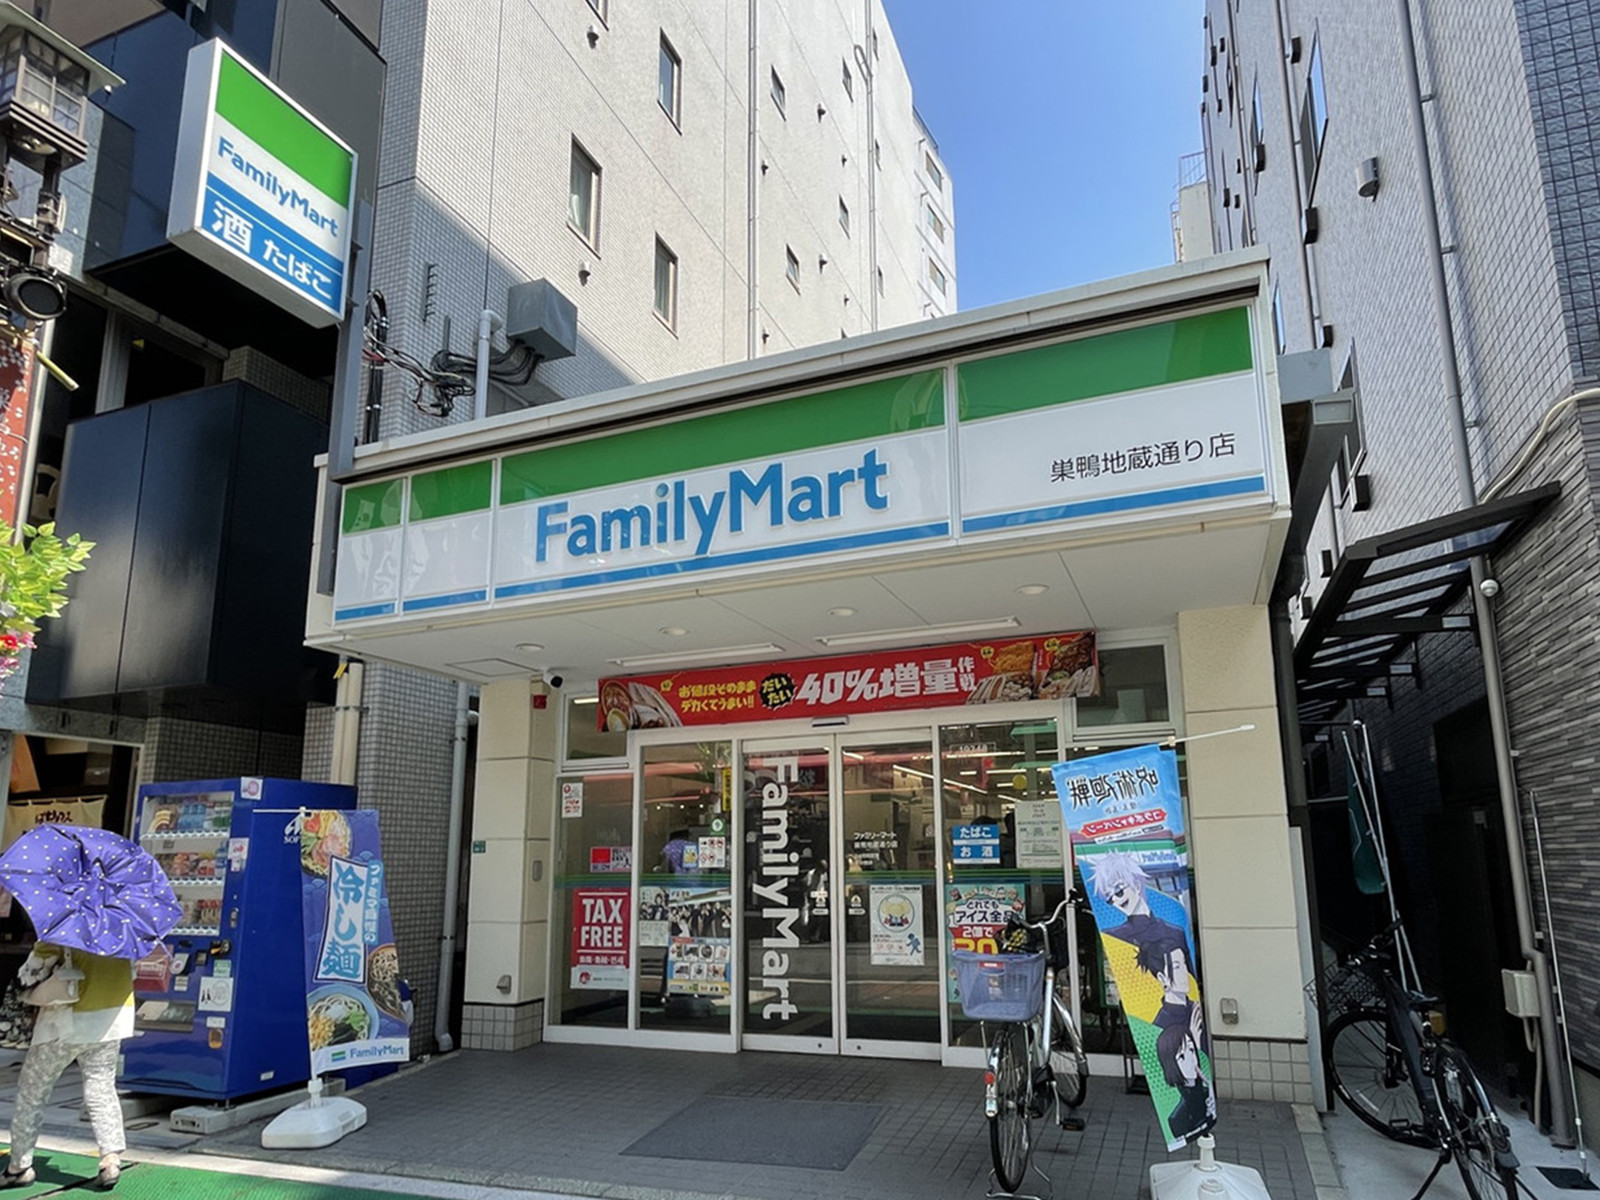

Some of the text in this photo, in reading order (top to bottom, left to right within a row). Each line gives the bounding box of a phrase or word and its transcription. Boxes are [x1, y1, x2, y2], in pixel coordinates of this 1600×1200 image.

[218, 136, 339, 238] FamilyMart
[212, 200, 332, 300] 酒 たばこ
[1051, 432, 1236, 483] 巣鴨地蔵通り店
[536, 447, 889, 558] FamilyMart
[960, 826, 992, 838] たばこ
[582, 898, 623, 924] TAX
[752, 755, 799, 1021] FamilyMart
[966, 900, 999, 910] どれでも
[321, 861, 365, 979] 冷し麺
[581, 926, 623, 947] FREE
[350, 1044, 404, 1058] FamilyMart
